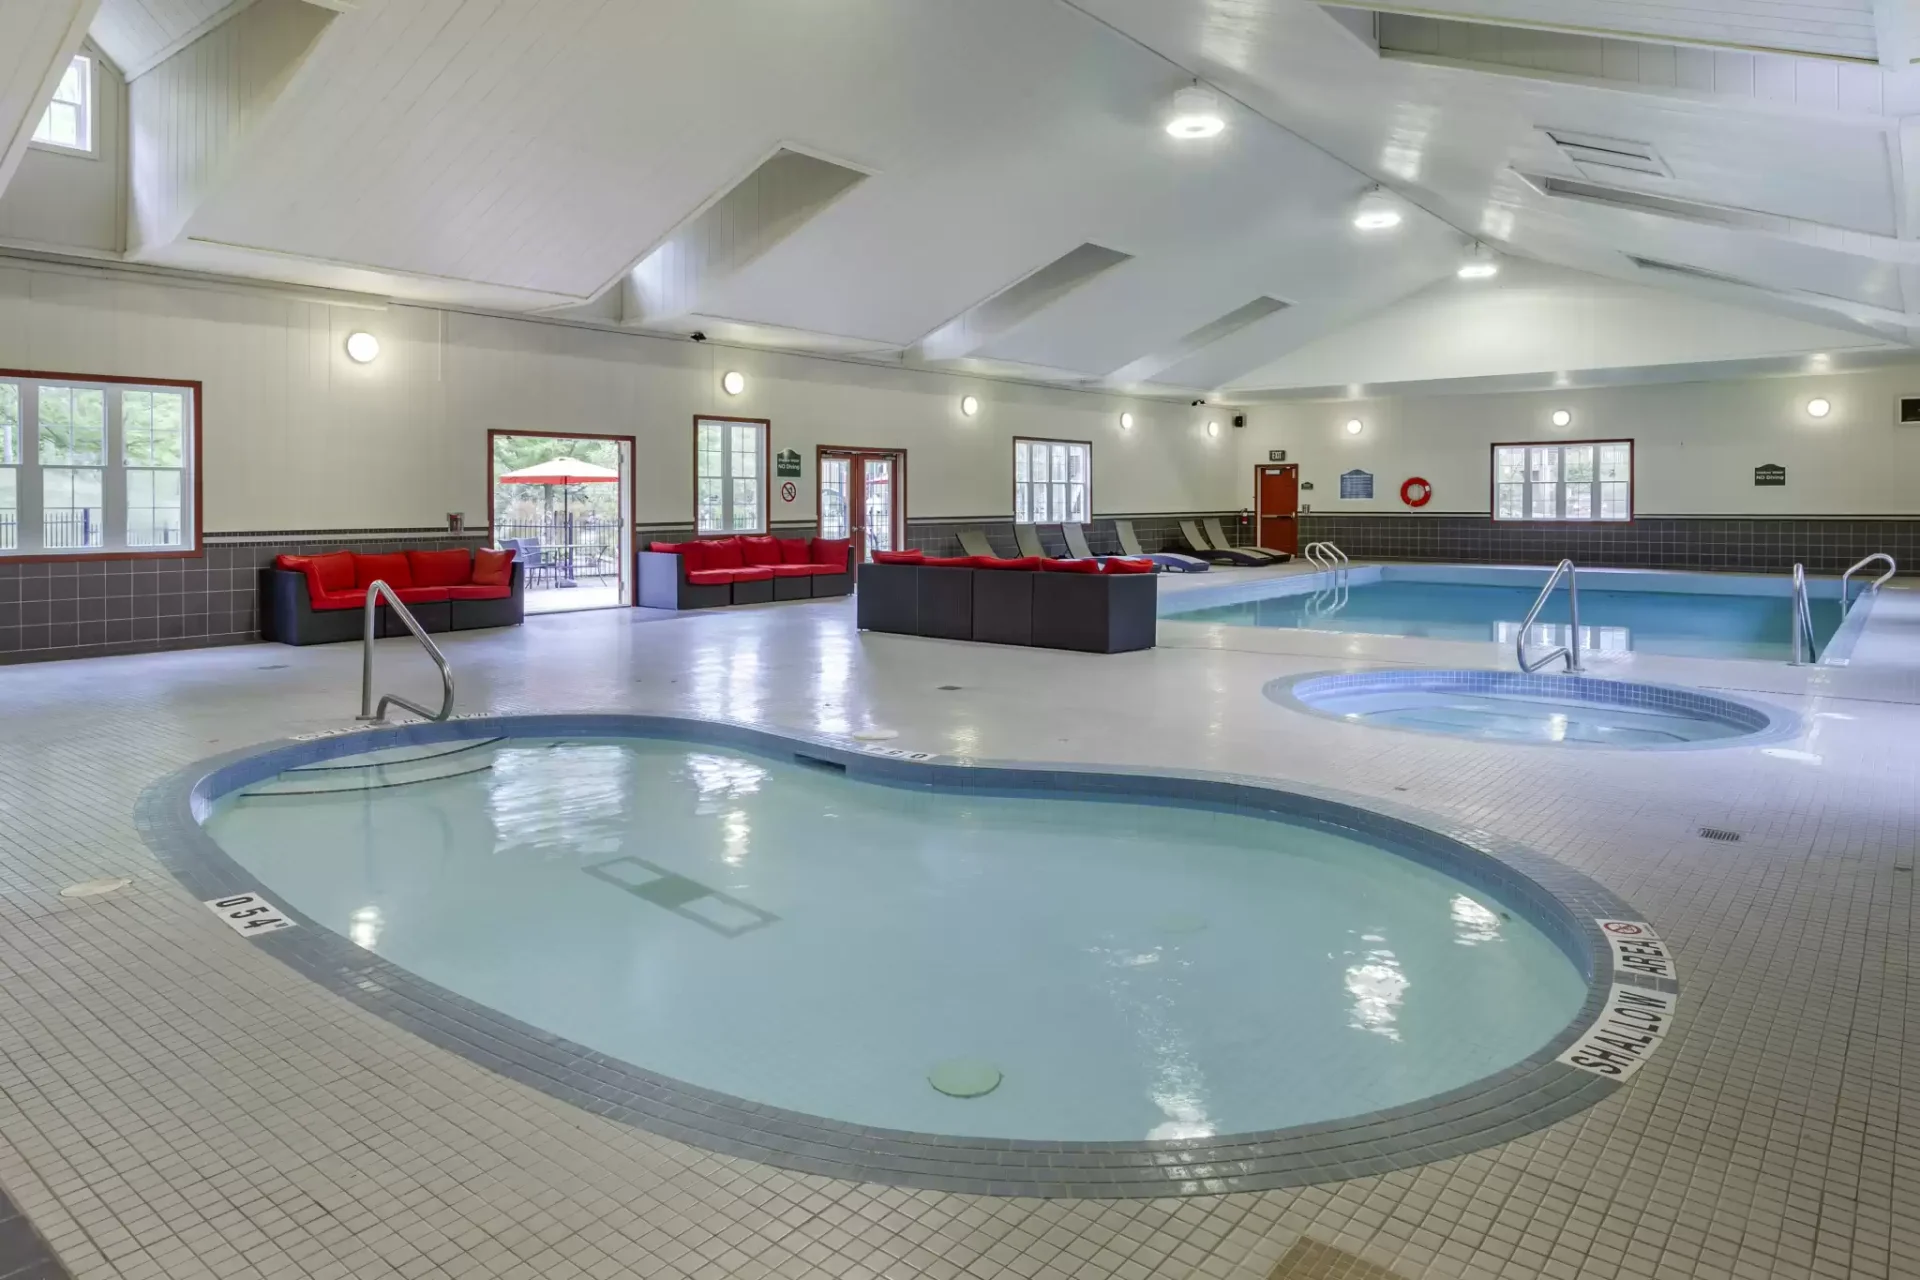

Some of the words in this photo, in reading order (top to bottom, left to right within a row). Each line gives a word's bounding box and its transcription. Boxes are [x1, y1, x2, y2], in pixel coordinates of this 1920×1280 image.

[786, 463, 800, 471] Diving
[1272, 452, 1282, 460] EXIT
[1616, 939, 1669, 977] AREA
[1570, 990, 1667, 1075] SHALLOW
